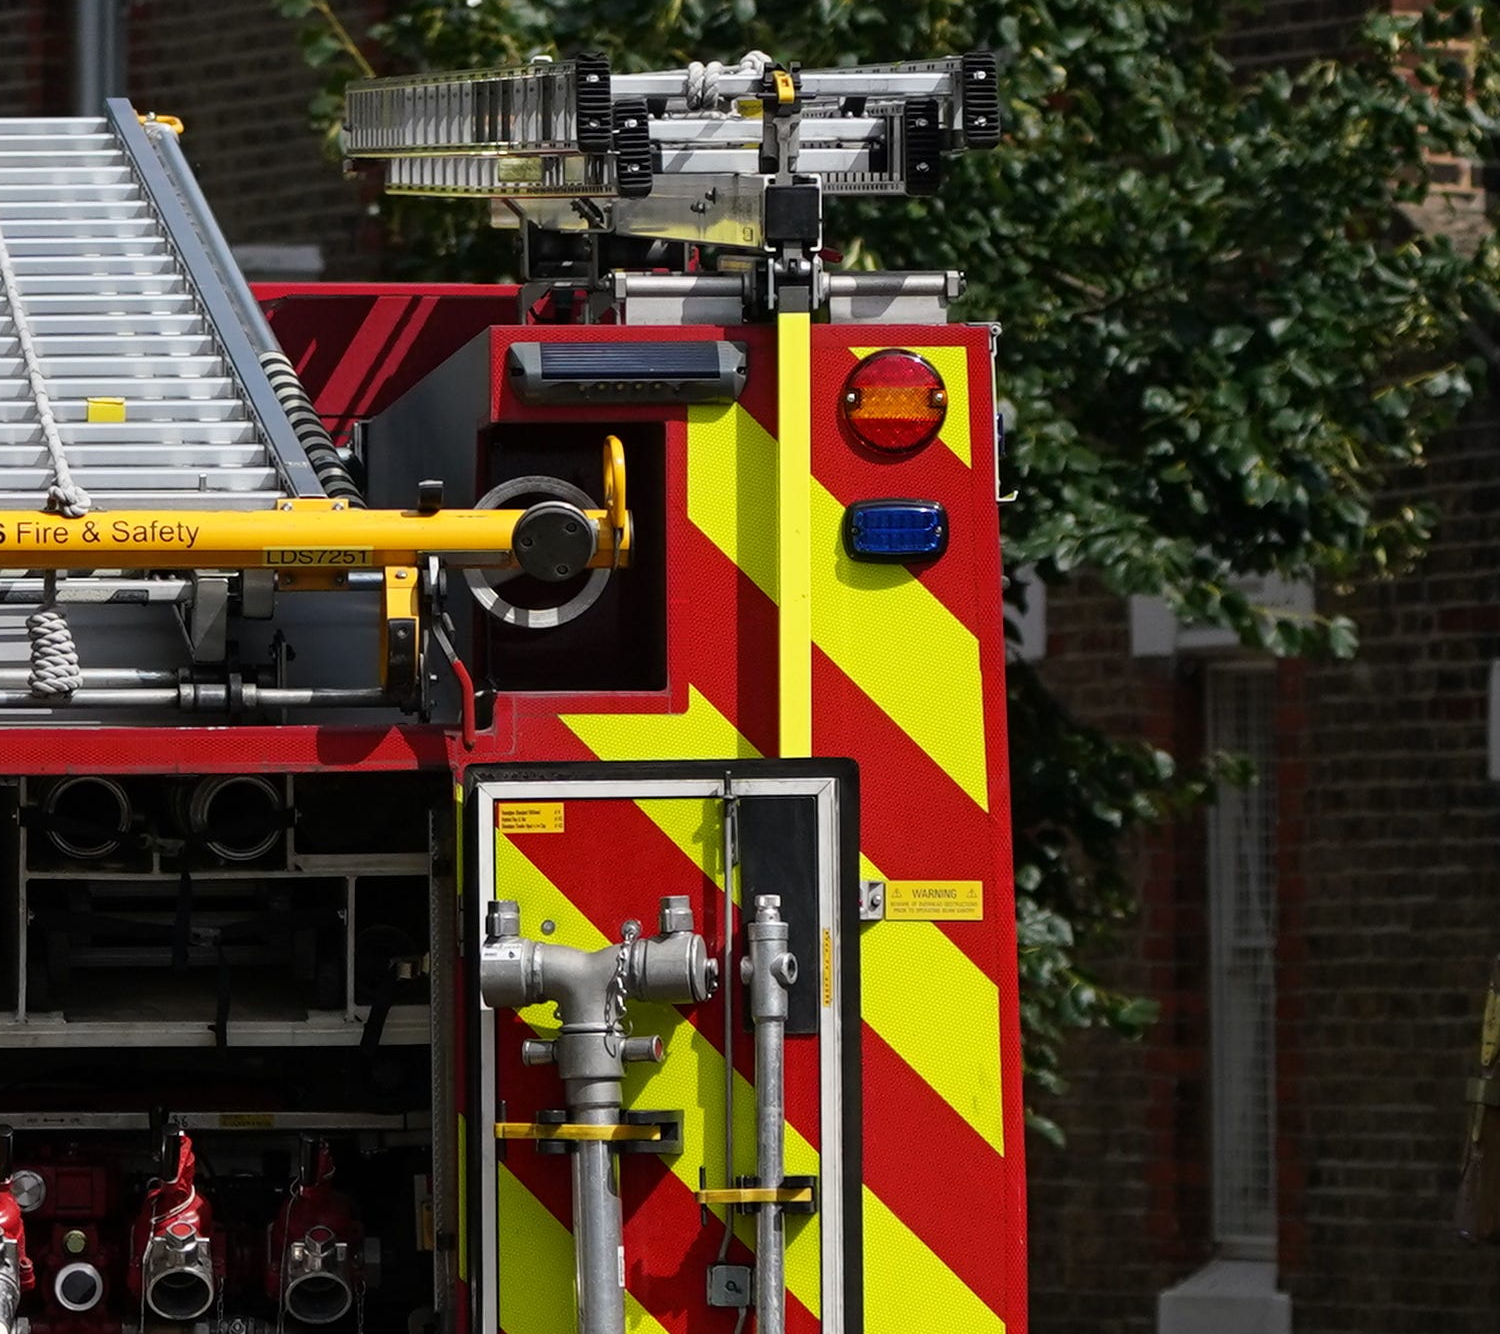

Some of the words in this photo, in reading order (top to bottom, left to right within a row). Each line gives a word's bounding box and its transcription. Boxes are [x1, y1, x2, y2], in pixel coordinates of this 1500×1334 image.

[17, 522, 69, 544] Fire
[81, 522, 102, 543] &
[111, 520, 200, 548] Safety
[912, 889, 957, 898] WARNING
